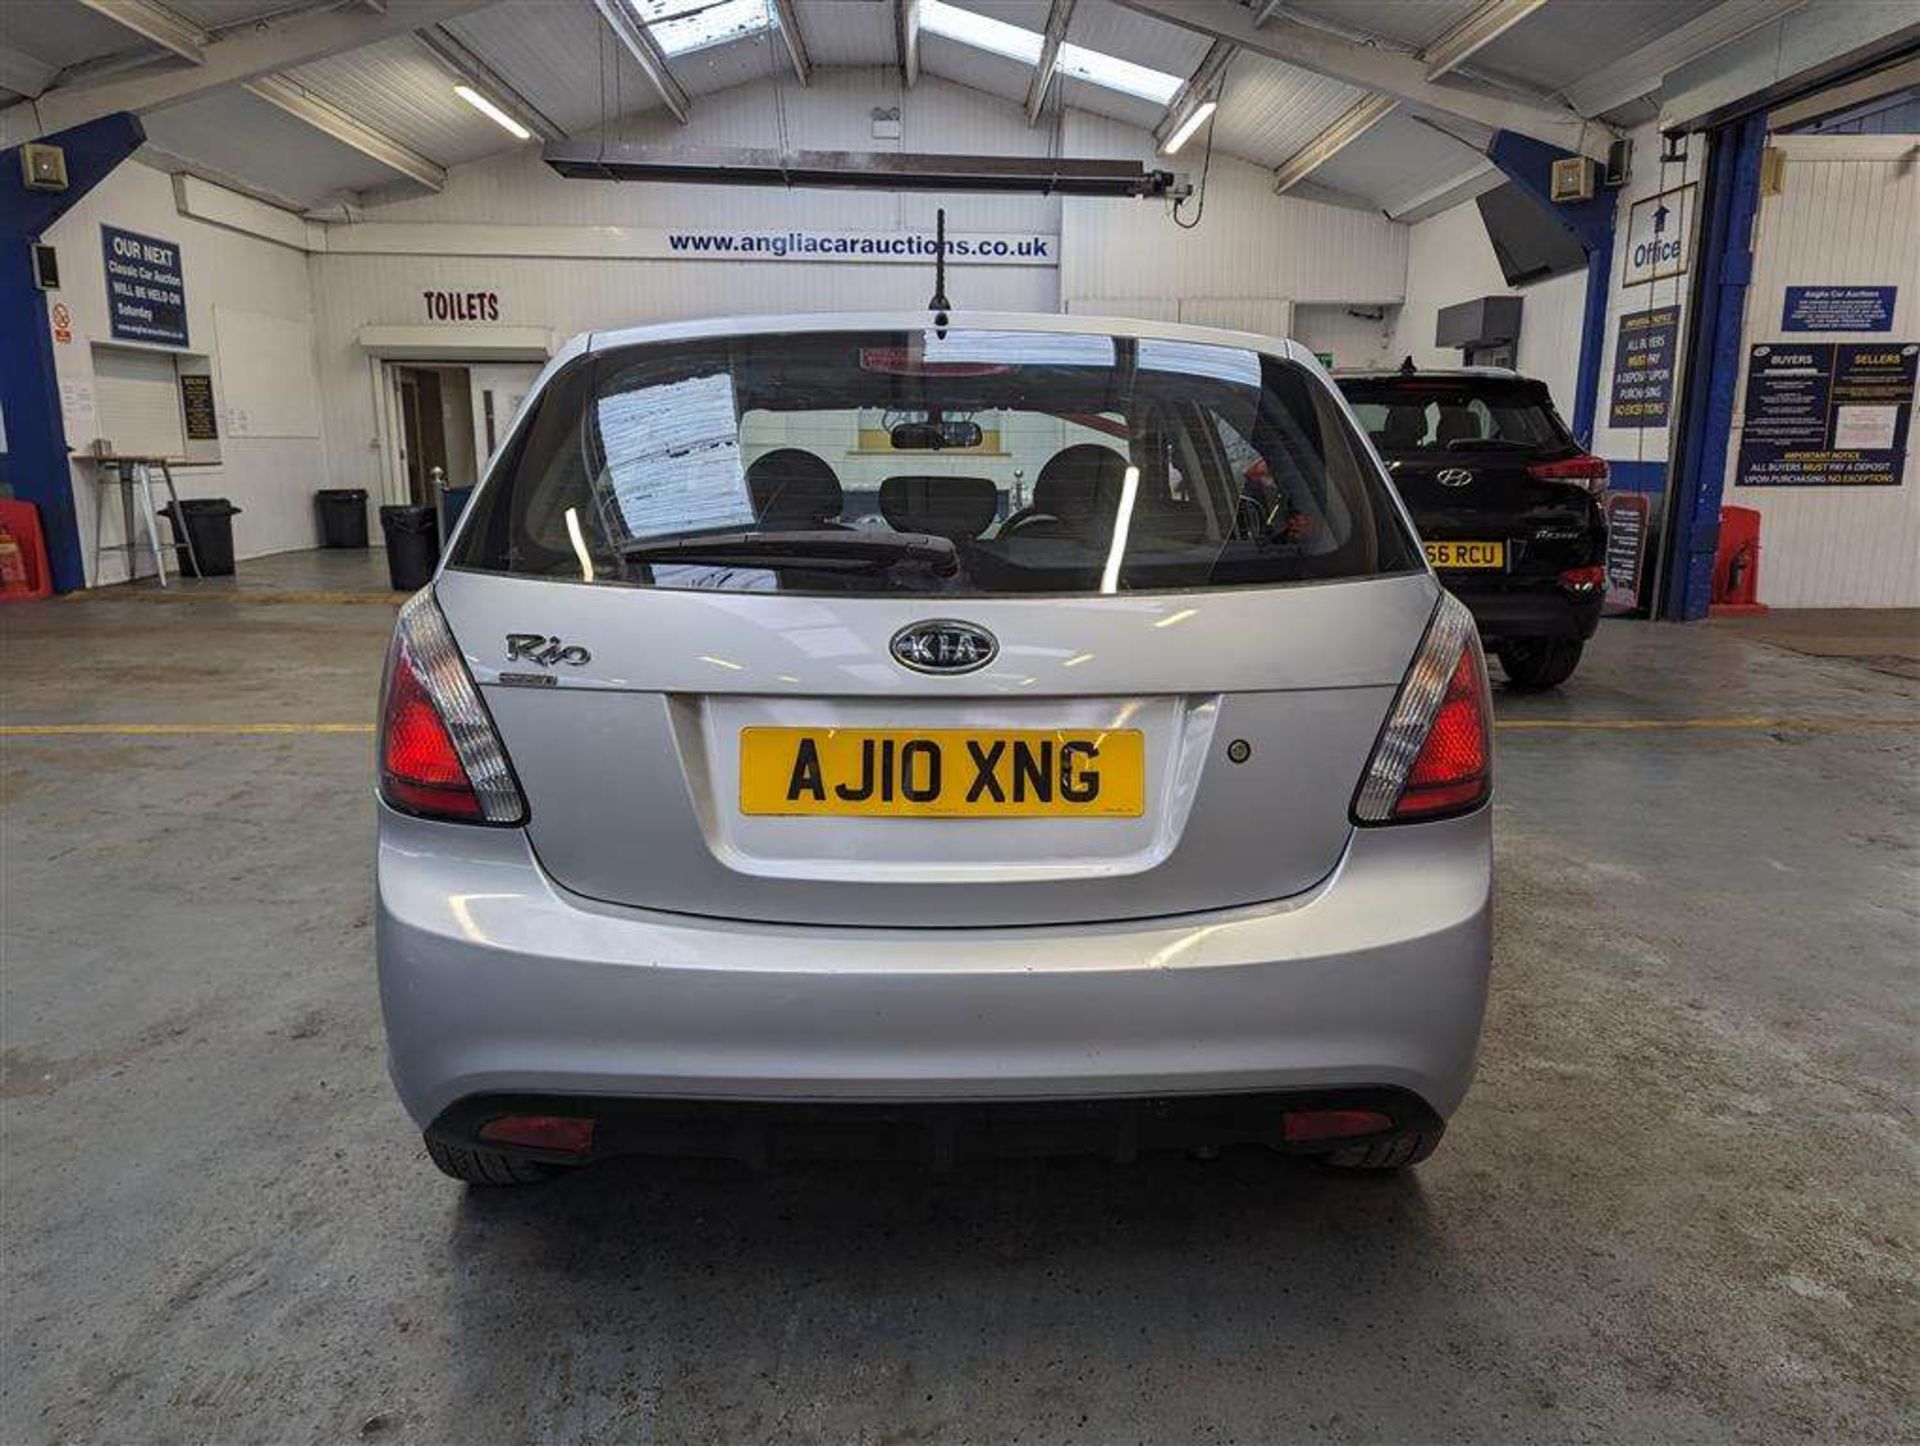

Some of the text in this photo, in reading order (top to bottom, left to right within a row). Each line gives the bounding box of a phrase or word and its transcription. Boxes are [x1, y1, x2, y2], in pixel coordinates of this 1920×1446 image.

[113, 236, 173, 267] OUR NEXT
[669, 232, 1048, 257] www.angliacarauctions.co.uk
[1633, 240, 1681, 268] Office
[109, 260, 138, 278] Classic
[139, 266, 153, 280] Car
[113, 281, 182, 306] WILL BE HELD ON
[423, 291, 499, 321] TOILETS
[1770, 354, 1814, 365] BUYERS
[1855, 353, 1901, 364] SELLERS
[1750, 462, 1767, 472] ALL
[1768, 462, 1802, 472] BUYERS
[1456, 545, 1495, 564] RCU
[505, 633, 592, 667] Rio
[908, 632, 982, 663] KIA
[787, 737, 1100, 803] AJ10 XNG
